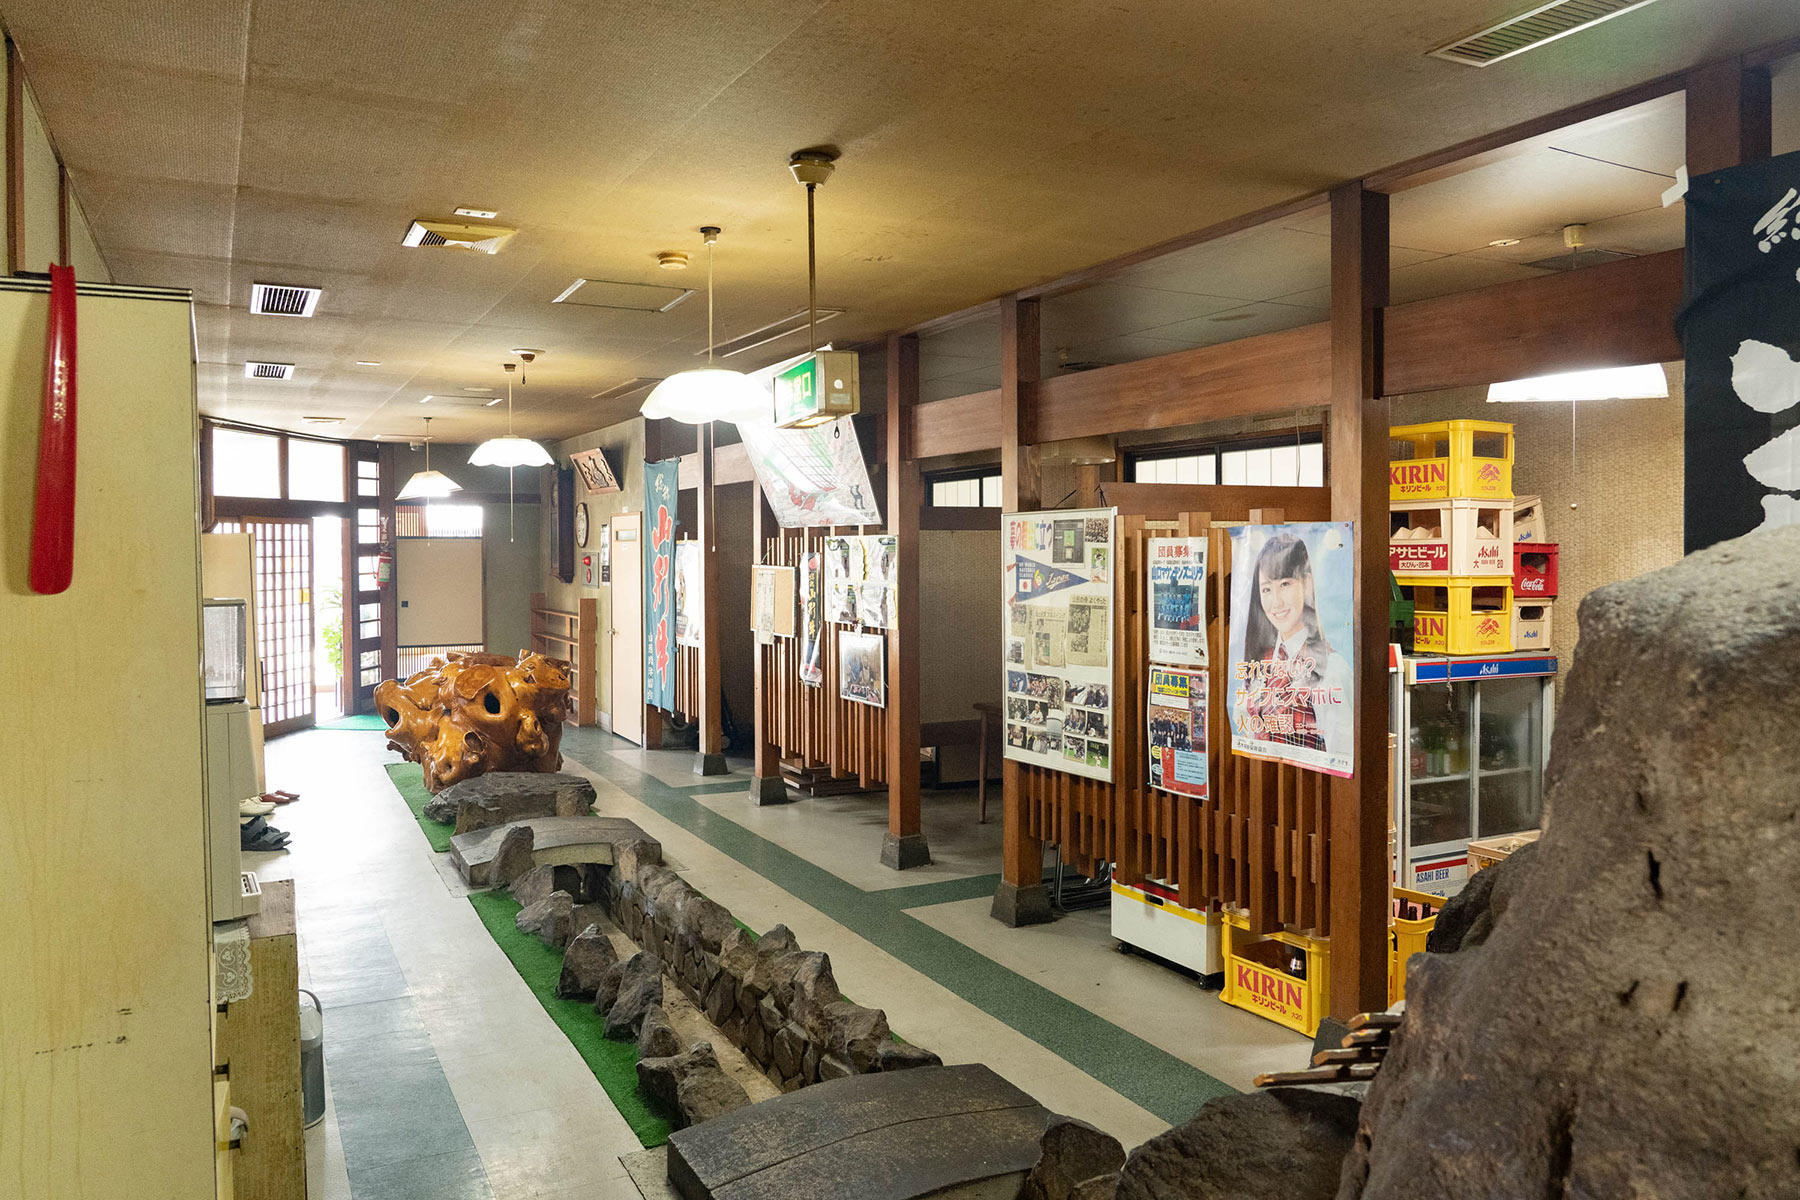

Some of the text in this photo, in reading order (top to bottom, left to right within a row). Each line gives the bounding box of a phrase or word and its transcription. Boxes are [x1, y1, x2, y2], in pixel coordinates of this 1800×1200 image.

[1390, 463, 1445, 485] KIRIN
[1400, 485, 1431, 493] キリンビール
[1518, 530, 1532, 541] Asahi
[1389, 546, 1447, 559] アサヒビール
[1478, 545, 1499, 558] Asahi
[1414, 617, 1444, 636] RIN
[1524, 630, 1538, 638] Asahi
[1480, 663, 1499, 675] Asahi
[1235, 687, 1343, 706] サイフにスマホに
[1237, 714, 1297, 734] 火の確認
[1416, 868, 1450, 883] ASAHI BEER
[1238, 964, 1302, 1010] KIRIN
[1252, 994, 1287, 1014] キリンビール
